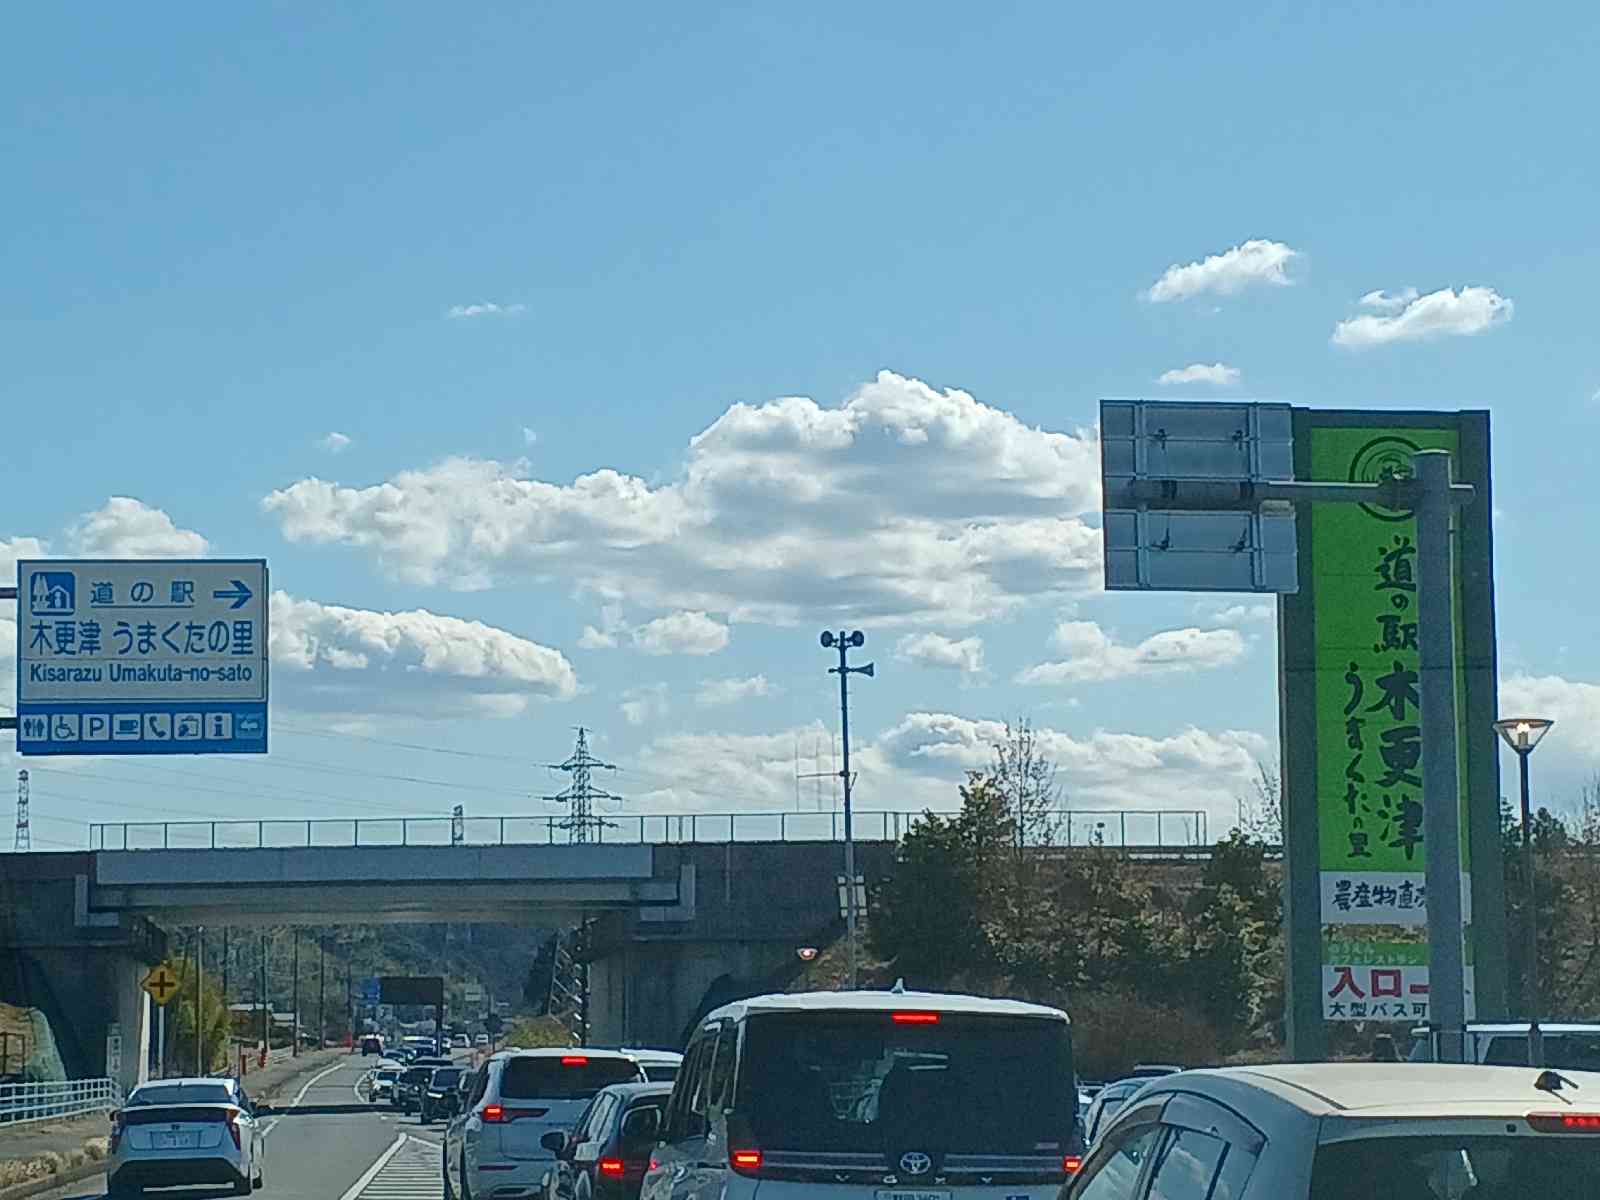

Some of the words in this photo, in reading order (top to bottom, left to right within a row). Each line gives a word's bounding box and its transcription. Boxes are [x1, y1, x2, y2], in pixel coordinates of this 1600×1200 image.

[90, 581, 195, 604] 道の駅
[30, 619, 102, 656] 木更津
[112, 619, 254, 656] うまくたの里
[30, 663, 102, 683] Kisarazu
[109, 663, 253, 683] Umakuta-no-sato
[1343, 661, 1372, 859] うまくたの里
[1327, 966, 1403, 999] 入口
[1328, 1002, 1428, 1018] 大型バス可
